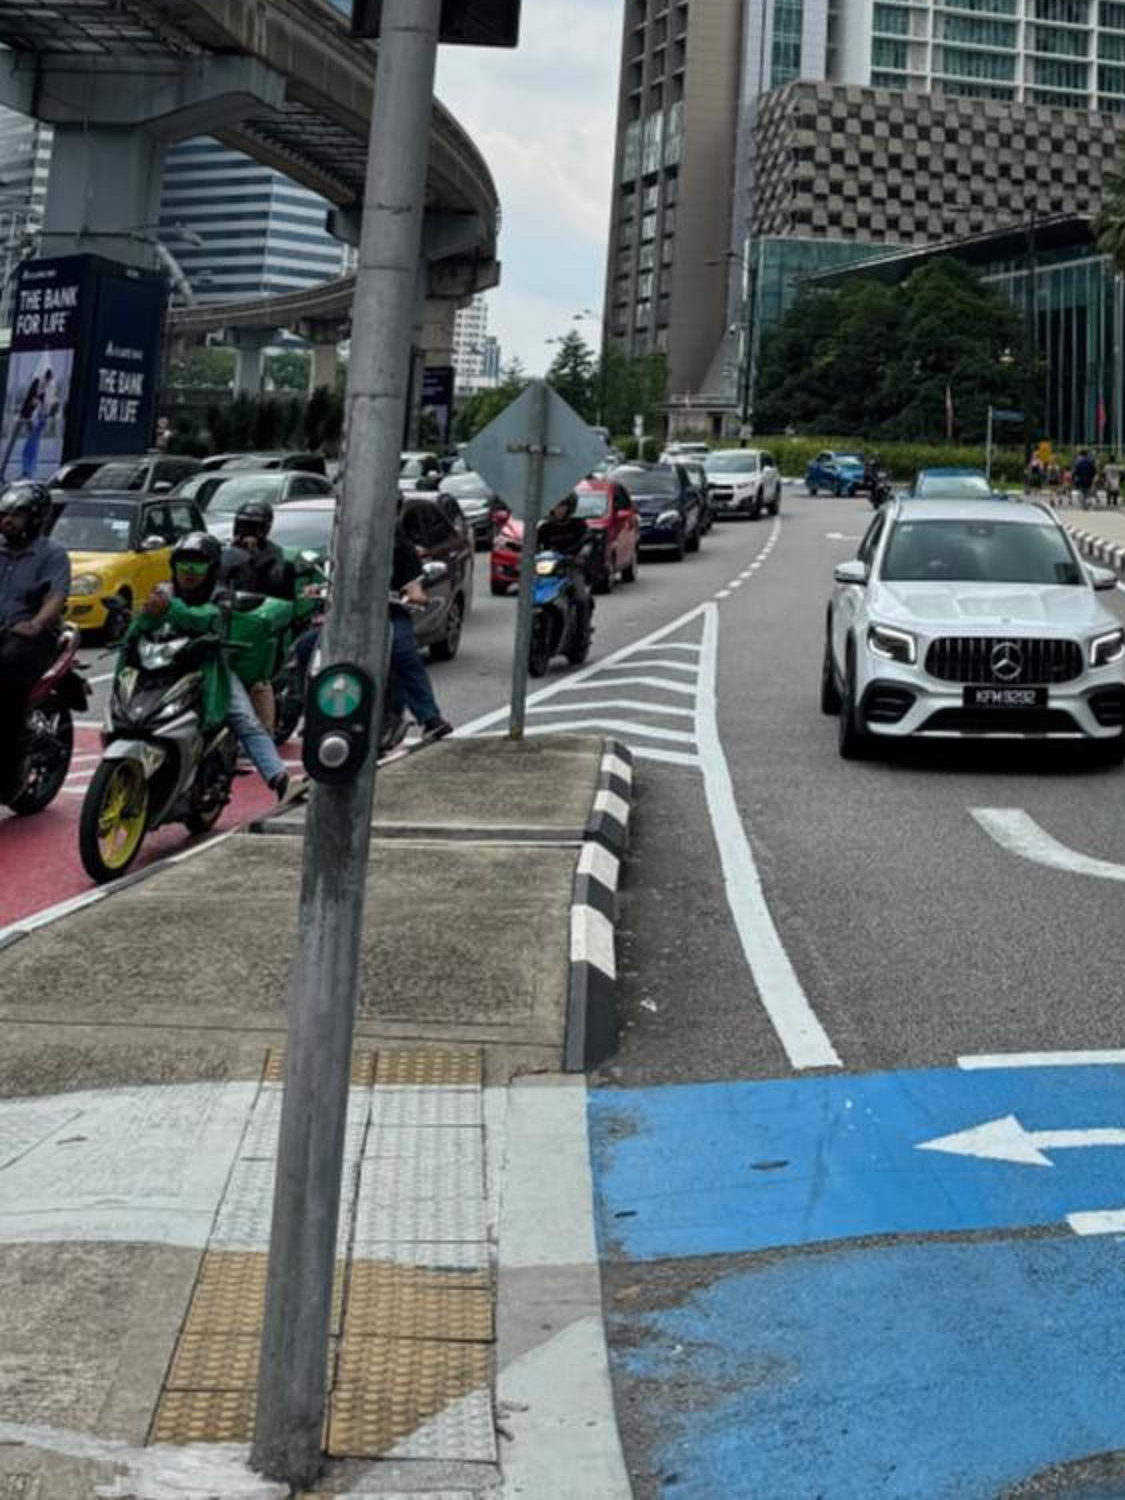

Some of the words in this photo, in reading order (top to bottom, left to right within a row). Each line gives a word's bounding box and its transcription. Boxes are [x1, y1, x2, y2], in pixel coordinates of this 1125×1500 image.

[19, 289, 42, 311] THE
[43, 286, 79, 309] BANK
[15, 313, 41, 336] FOR
[42, 311, 68, 334] LIFE
[98, 368, 116, 393] THE
[117, 370, 144, 397] BANK
[97, 396, 118, 421] FOR
